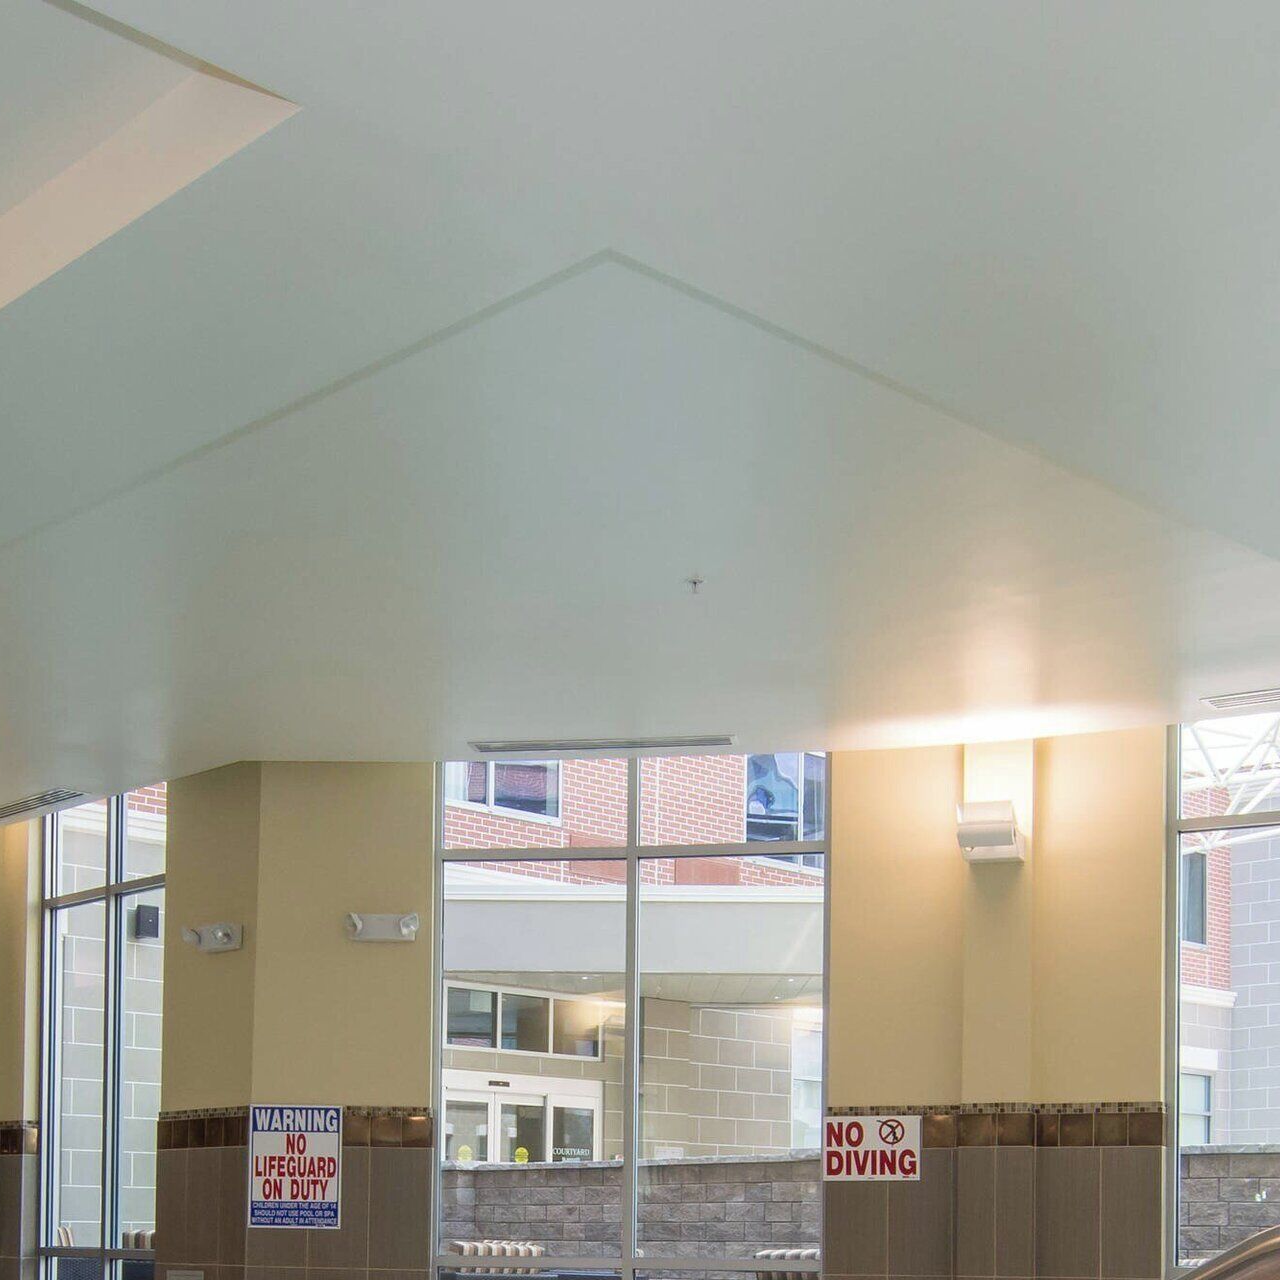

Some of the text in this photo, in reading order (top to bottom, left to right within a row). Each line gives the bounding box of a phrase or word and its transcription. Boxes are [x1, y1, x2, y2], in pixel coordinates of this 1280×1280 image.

[255, 1108, 338, 1132] WARNING
[286, 1133, 306, 1155] NO
[826, 1121, 864, 1147] NO
[255, 1156, 336, 1178] LIFEGUARD
[826, 1149, 917, 1176] DIVING
[263, 1178, 329, 1200] ON DUTY
[254, 1209, 276, 1217] SHOULD
[276, 1209, 287, 1217] NOT
